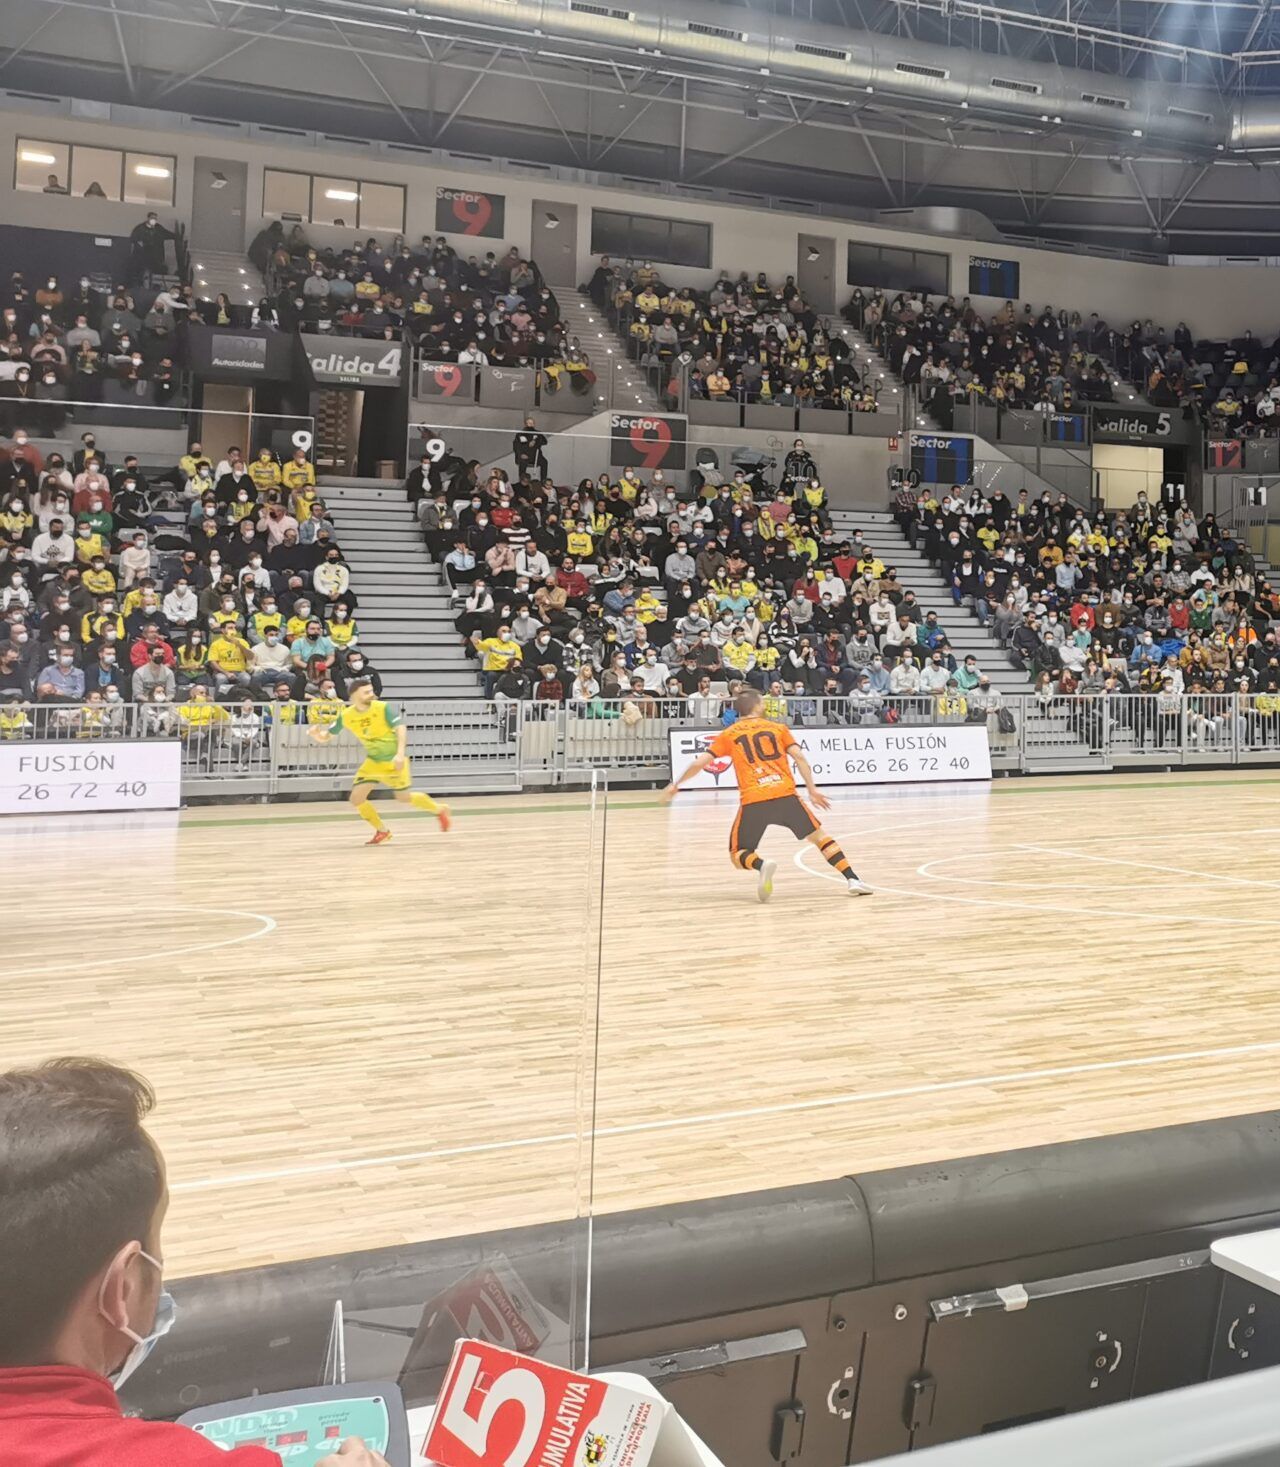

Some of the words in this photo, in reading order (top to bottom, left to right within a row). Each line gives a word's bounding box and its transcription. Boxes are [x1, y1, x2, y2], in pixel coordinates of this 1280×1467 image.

[436, 187, 481, 203] Sector
[452, 191, 492, 237] 9
[969, 256, 1002, 269] Sector
[212, 357, 265, 370] Autoridades
[306, 351, 377, 375] alida
[378, 348, 402, 377] 4
[421, 362, 455, 373] Sector
[434, 363, 462, 397] 9
[611, 415, 660, 430] Sector
[1050, 413, 1073, 422] Sector
[1155, 412, 1171, 436] 5
[291, 430, 312, 452] 9
[425, 438, 446, 462] 9
[629, 416, 673, 468] 9
[910, 434, 952, 450] Sector
[1208, 440, 1233, 448] Sector
[1214, 440, 1242, 469] 12
[734, 730, 782, 764] 10
[820, 738, 875, 751] MELLA
[885, 733, 947, 750] FUSIÓN
[18, 750, 115, 773] FUSIÓN
[845, 759, 877, 774] 626
[888, 758, 909, 772] 26
[919, 758, 940, 771] 72
[949, 757, 970, 770] 40
[18, 783, 50, 800] 26
[69, 782, 98, 799] 72
[115, 781, 147, 797] 40
[441, 1353, 546, 1467] 5
